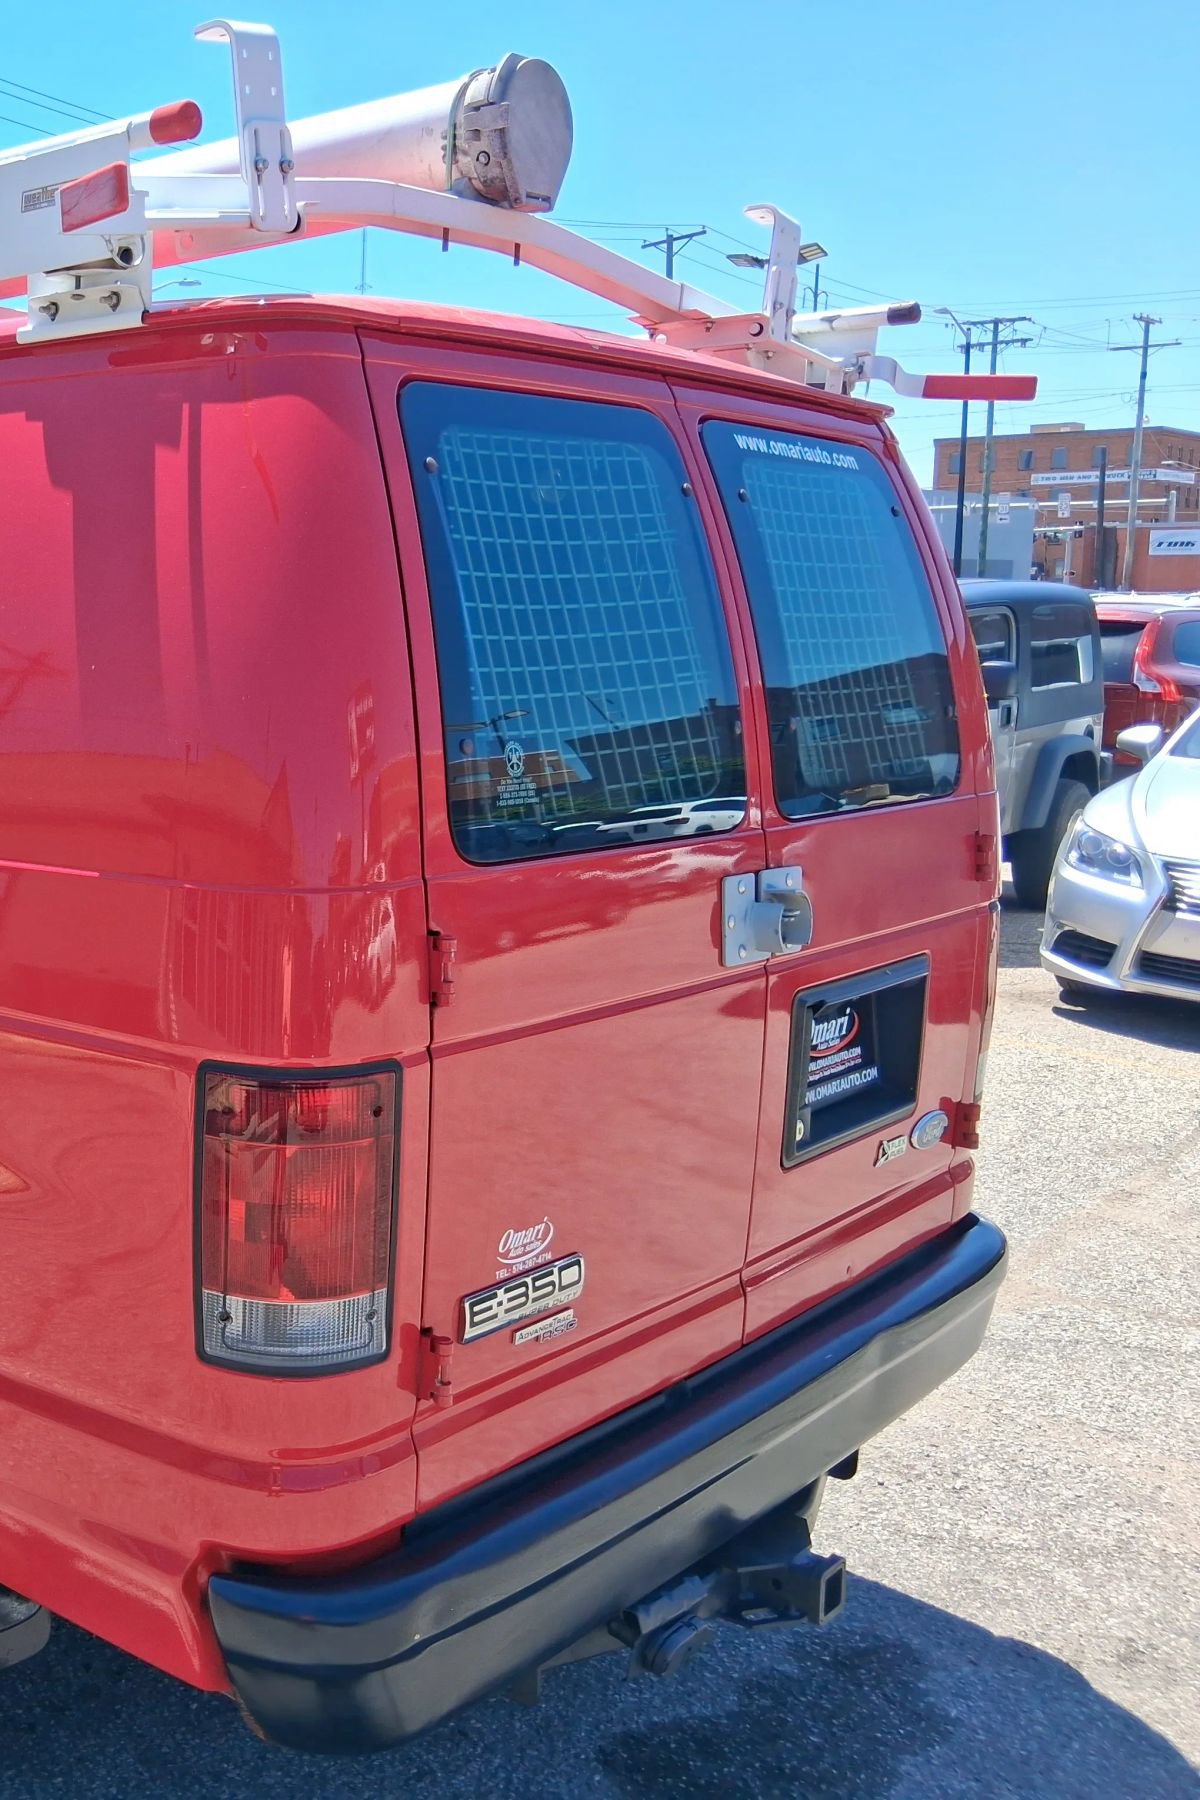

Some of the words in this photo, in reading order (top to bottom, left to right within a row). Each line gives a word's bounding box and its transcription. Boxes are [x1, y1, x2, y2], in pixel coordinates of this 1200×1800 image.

[734, 433, 859, 470] www.omariauto.com
[811, 1007, 851, 1045] mari
[499, 1216, 548, 1253] Omari
[495, 1268, 511, 1281] TEL:
[468, 1258, 582, 1329] E-350
